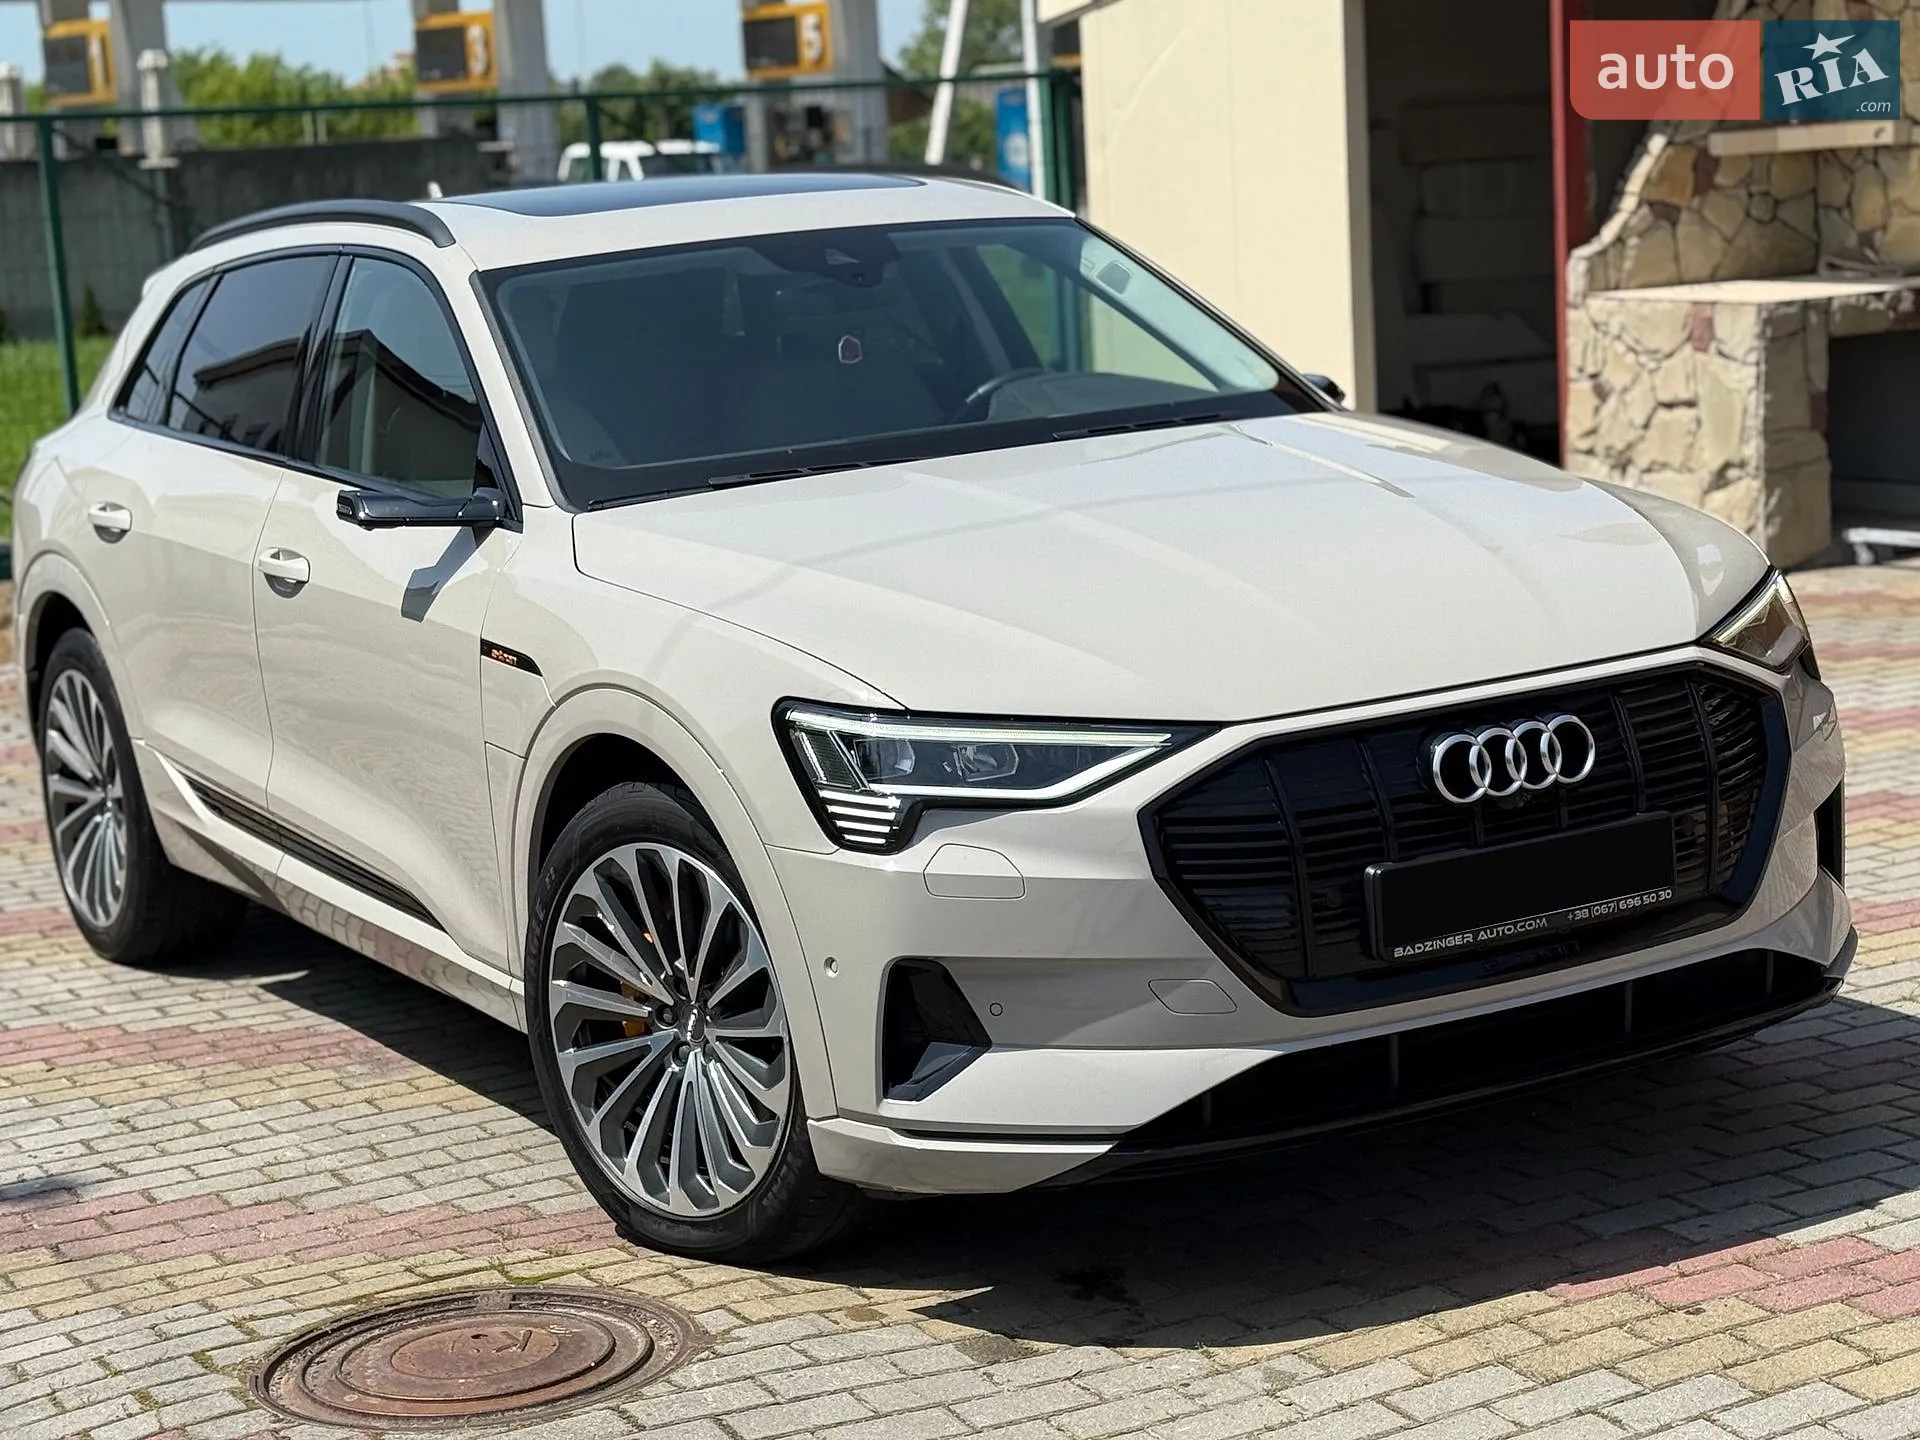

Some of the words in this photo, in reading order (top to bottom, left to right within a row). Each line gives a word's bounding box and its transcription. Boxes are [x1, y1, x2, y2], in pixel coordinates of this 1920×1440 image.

[467, 24, 488, 76] 3
[800, 13, 822, 63] 5
[1394, 933, 1473, 957] BADZINGER
[1477, 917, 1547, 941] AUTO.COM
[1567, 908, 1589, 921] +38
[1591, 901, 1617, 918] (067)
[1619, 896, 1641, 910] 696
[1642, 893, 1657, 905] 50
[1658, 889, 1672, 901] 30
